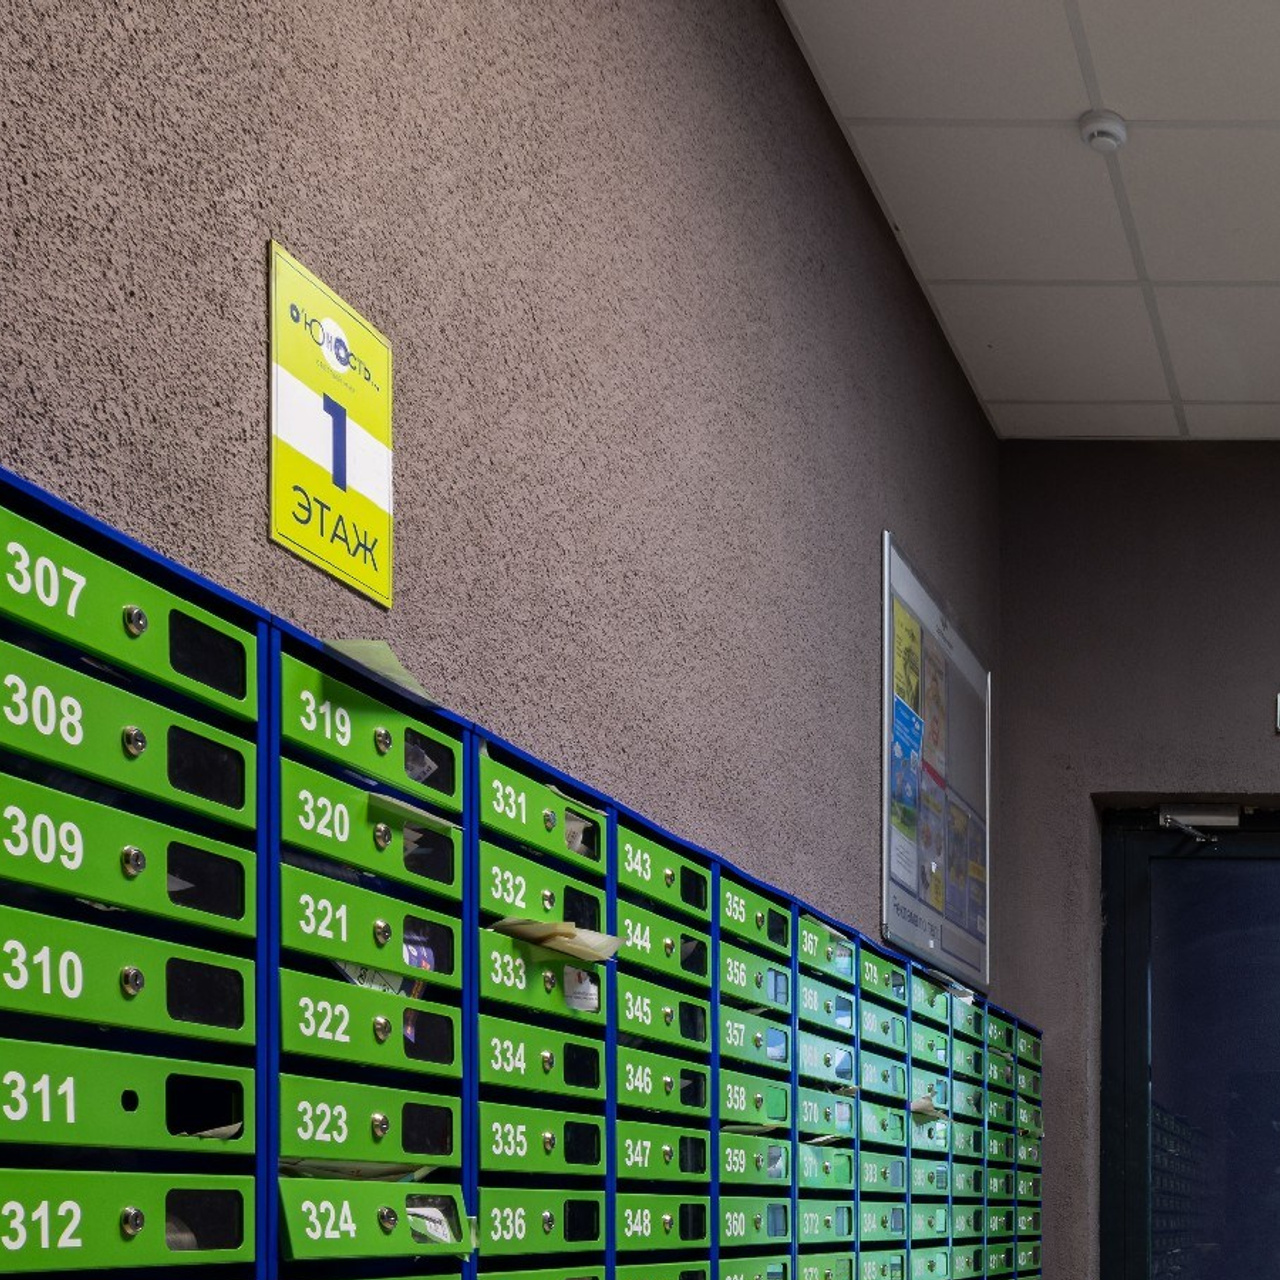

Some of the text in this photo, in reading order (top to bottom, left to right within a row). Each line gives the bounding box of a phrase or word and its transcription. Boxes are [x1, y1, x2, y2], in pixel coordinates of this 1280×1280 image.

[323, 392, 347, 492] 1
[292, 485, 379, 572] ЭТАЖ
[7, 542, 86, 617] 307
[4, 674, 83, 745] 308
[300, 691, 351, 746] 319
[299, 790, 349, 841] 320
[493, 780, 526, 824] 331
[4, 806, 83, 870] 309
[625, 844, 651, 880] 343
[491, 866, 525, 908] 332
[299, 894, 347, 941] 321
[726, 892, 746, 922] 355
[625, 919, 651, 953] 344
[802, 930, 818, 956] 367
[3, 940, 83, 998] 310
[491, 951, 526, 989] 333
[727, 958, 746, 987] 356
[299, 997, 350, 1042] 322
[625, 992, 651, 1025] 345
[726, 1020, 745, 1046] 357
[491, 1038, 526, 1074] 334
[3, 1071, 75, 1123] 311
[626, 1064, 652, 1094] 346
[727, 1084, 746, 1111] 358
[297, 1101, 348, 1143] 323
[802, 1100, 819, 1123] 370
[492, 1122, 527, 1156] 335
[625, 1139, 651, 1167] 347
[726, 1148, 746, 1173] 359
[2, 1201, 82, 1250] 312
[302, 1201, 356, 1239] 324
[491, 1208, 525, 1241] 336
[625, 1209, 651, 1237] 348
[726, 1212, 745, 1236] 360
